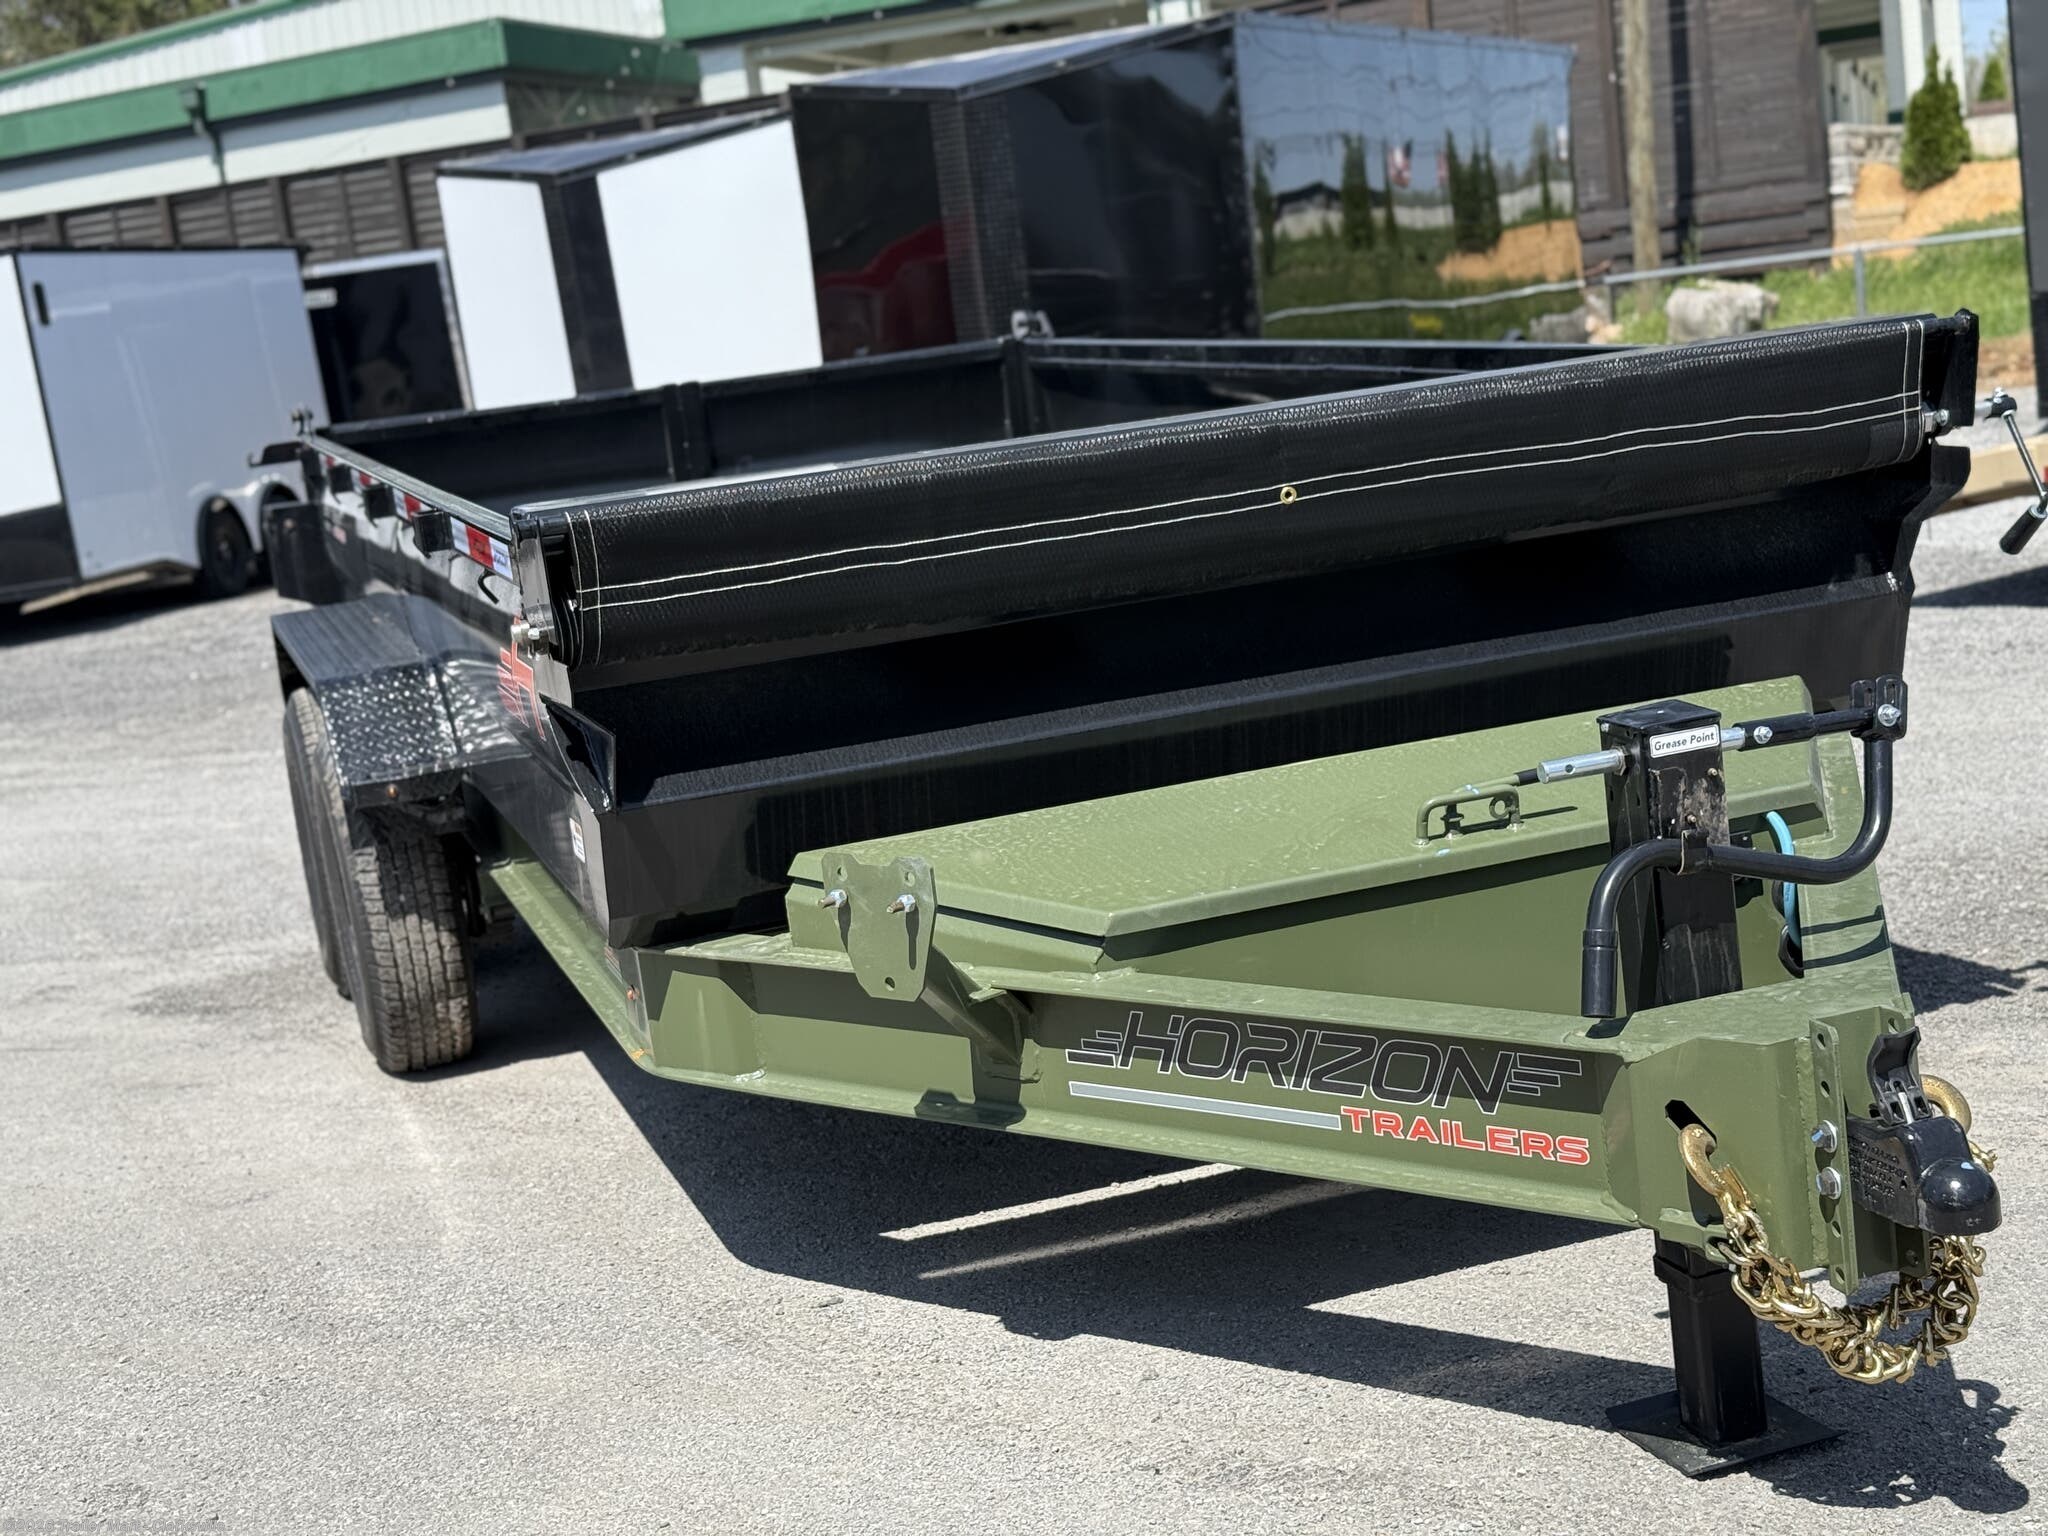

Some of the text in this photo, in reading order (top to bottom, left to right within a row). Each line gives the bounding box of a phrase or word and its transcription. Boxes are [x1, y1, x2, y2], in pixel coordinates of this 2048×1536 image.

[1654, 732, 1715, 751] Grease Point
[1117, 1010, 1514, 1115] HORIZON
[1341, 1105, 1591, 1166] TRAILERS
